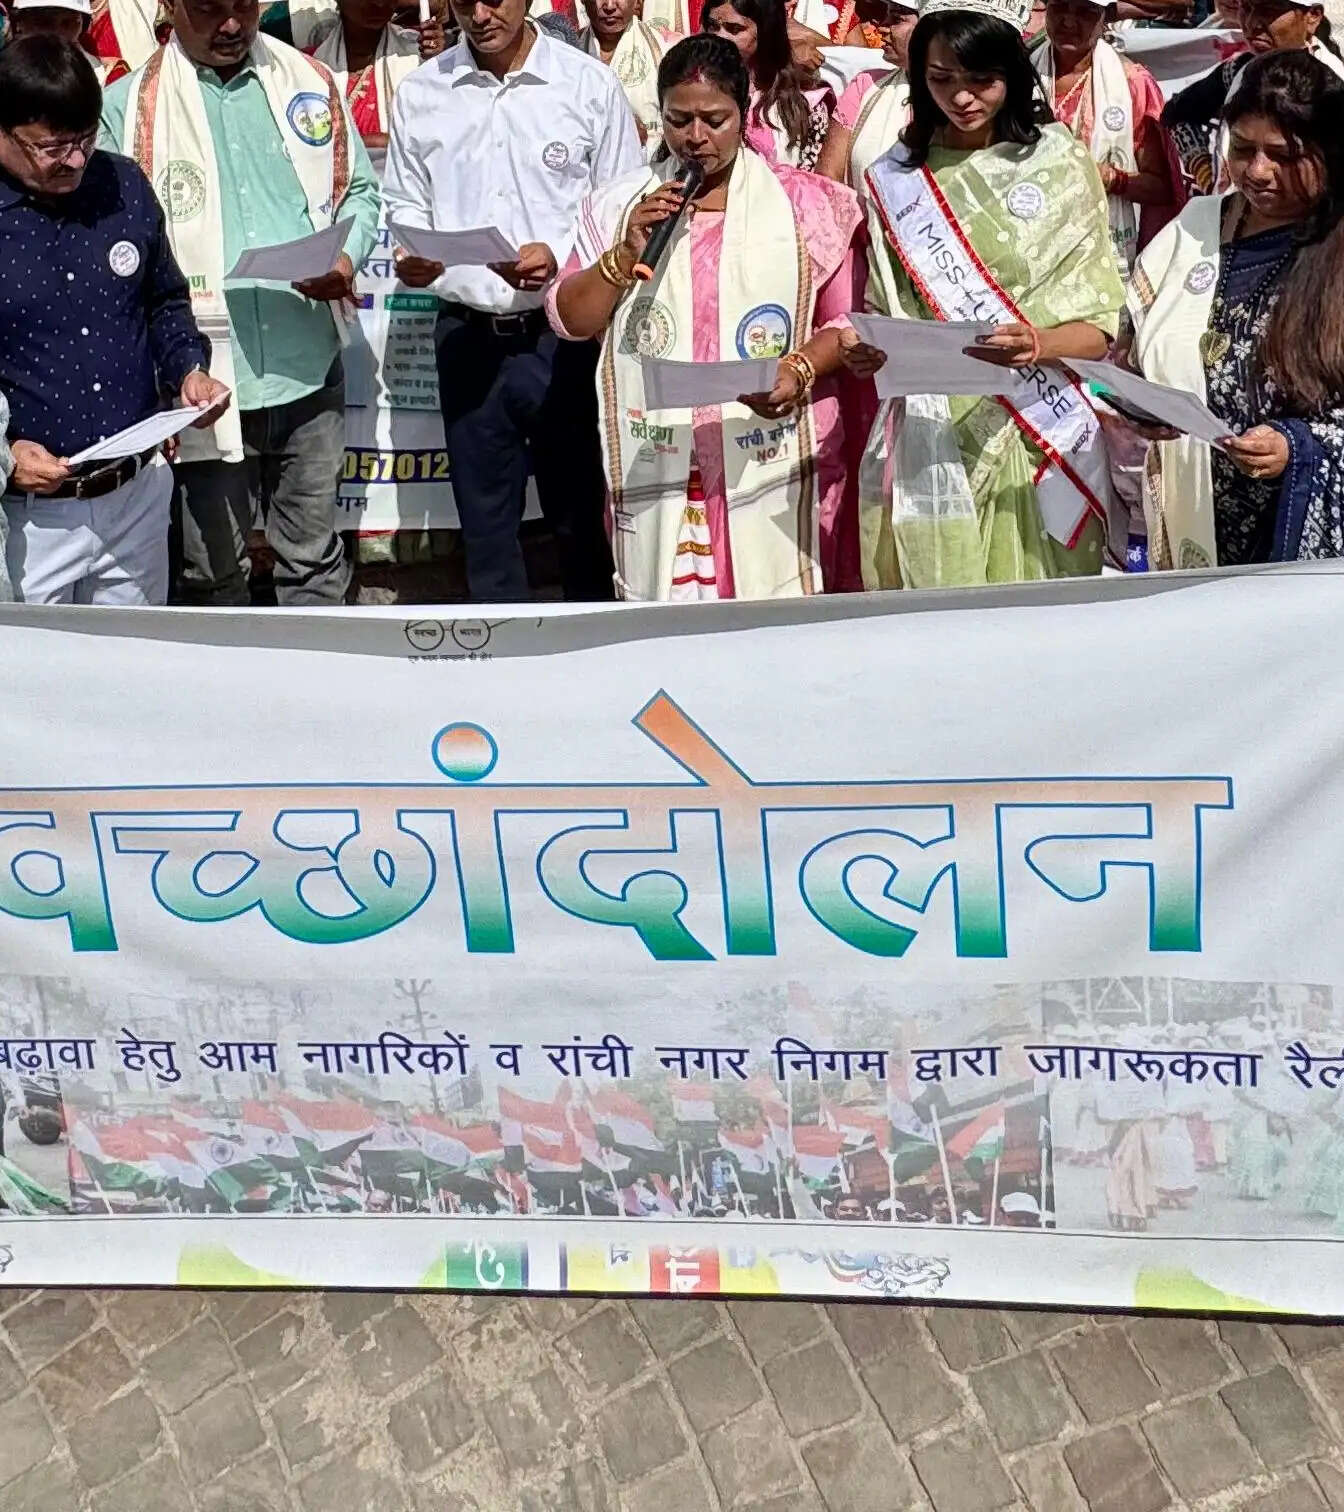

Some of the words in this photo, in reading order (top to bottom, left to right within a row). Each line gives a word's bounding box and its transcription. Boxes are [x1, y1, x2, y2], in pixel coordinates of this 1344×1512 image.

[918, 223, 965, 286] MISS
[734, 427, 765, 450] रांची
[119, 1029, 182, 1081] हेतु
[199, 1041, 278, 1076] आम
[298, 1030, 469, 1078] नागरिकों
[491, 1043, 524, 1077] व
[542, 1033, 632, 1081] रांची
[656, 1047, 751, 1082] नगर
[771, 1036, 888, 1083] निगम
[911, 1045, 1000, 1085] द्वारा
[1023, 1044, 1262, 1089] जागरूकता
